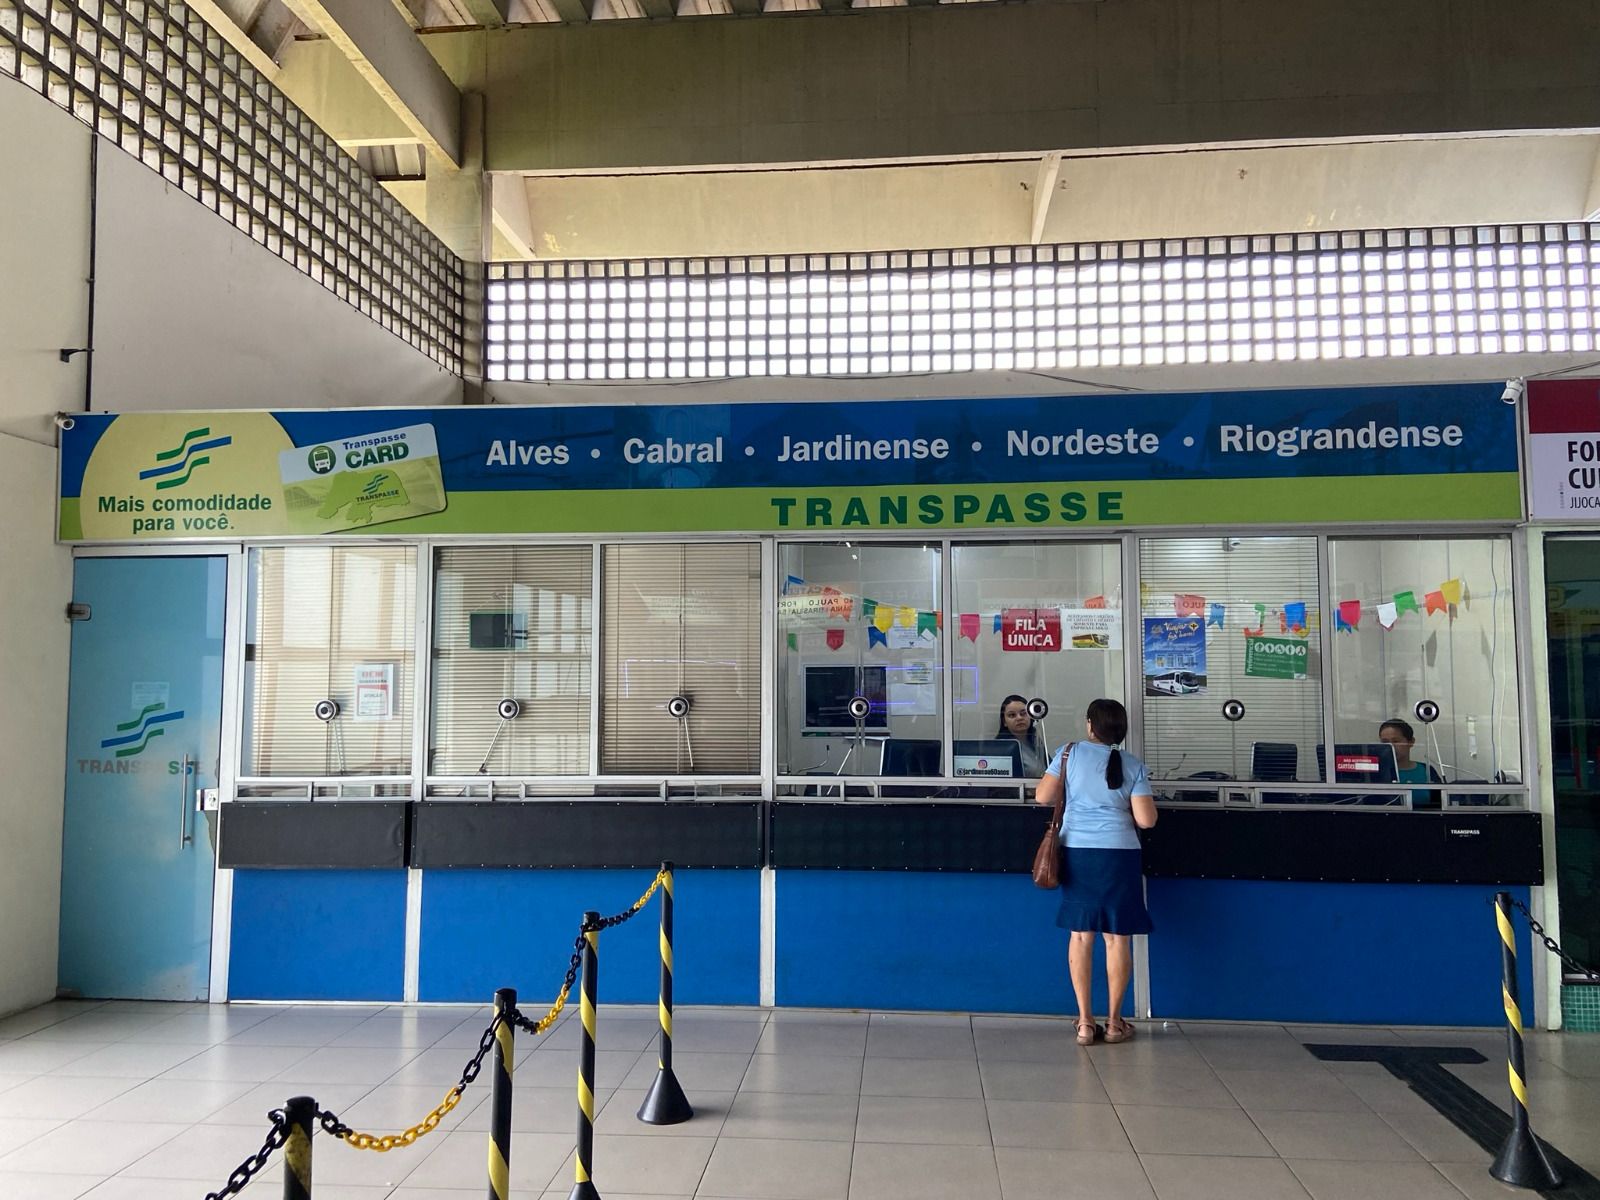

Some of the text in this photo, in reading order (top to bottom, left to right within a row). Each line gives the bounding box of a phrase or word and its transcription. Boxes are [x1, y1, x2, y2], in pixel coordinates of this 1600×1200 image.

[342, 432, 407, 451] Transpasse
[486, 420, 1464, 466] Alves Cabral Jardinense Nordeste Riograndense
[1567, 440, 1600, 462] FO
[345, 441, 409, 469] CARD
[1568, 467, 1600, 489] CU
[98, 493, 272, 513] Mais comodidade
[356, 489, 400, 503] TRANSPASSE
[770, 490, 1124, 526] TRANSPASSE
[132, 512, 235, 535] para você.
[1015, 618, 1047, 631] FILA
[1007, 630, 1054, 647] ÚNICA
